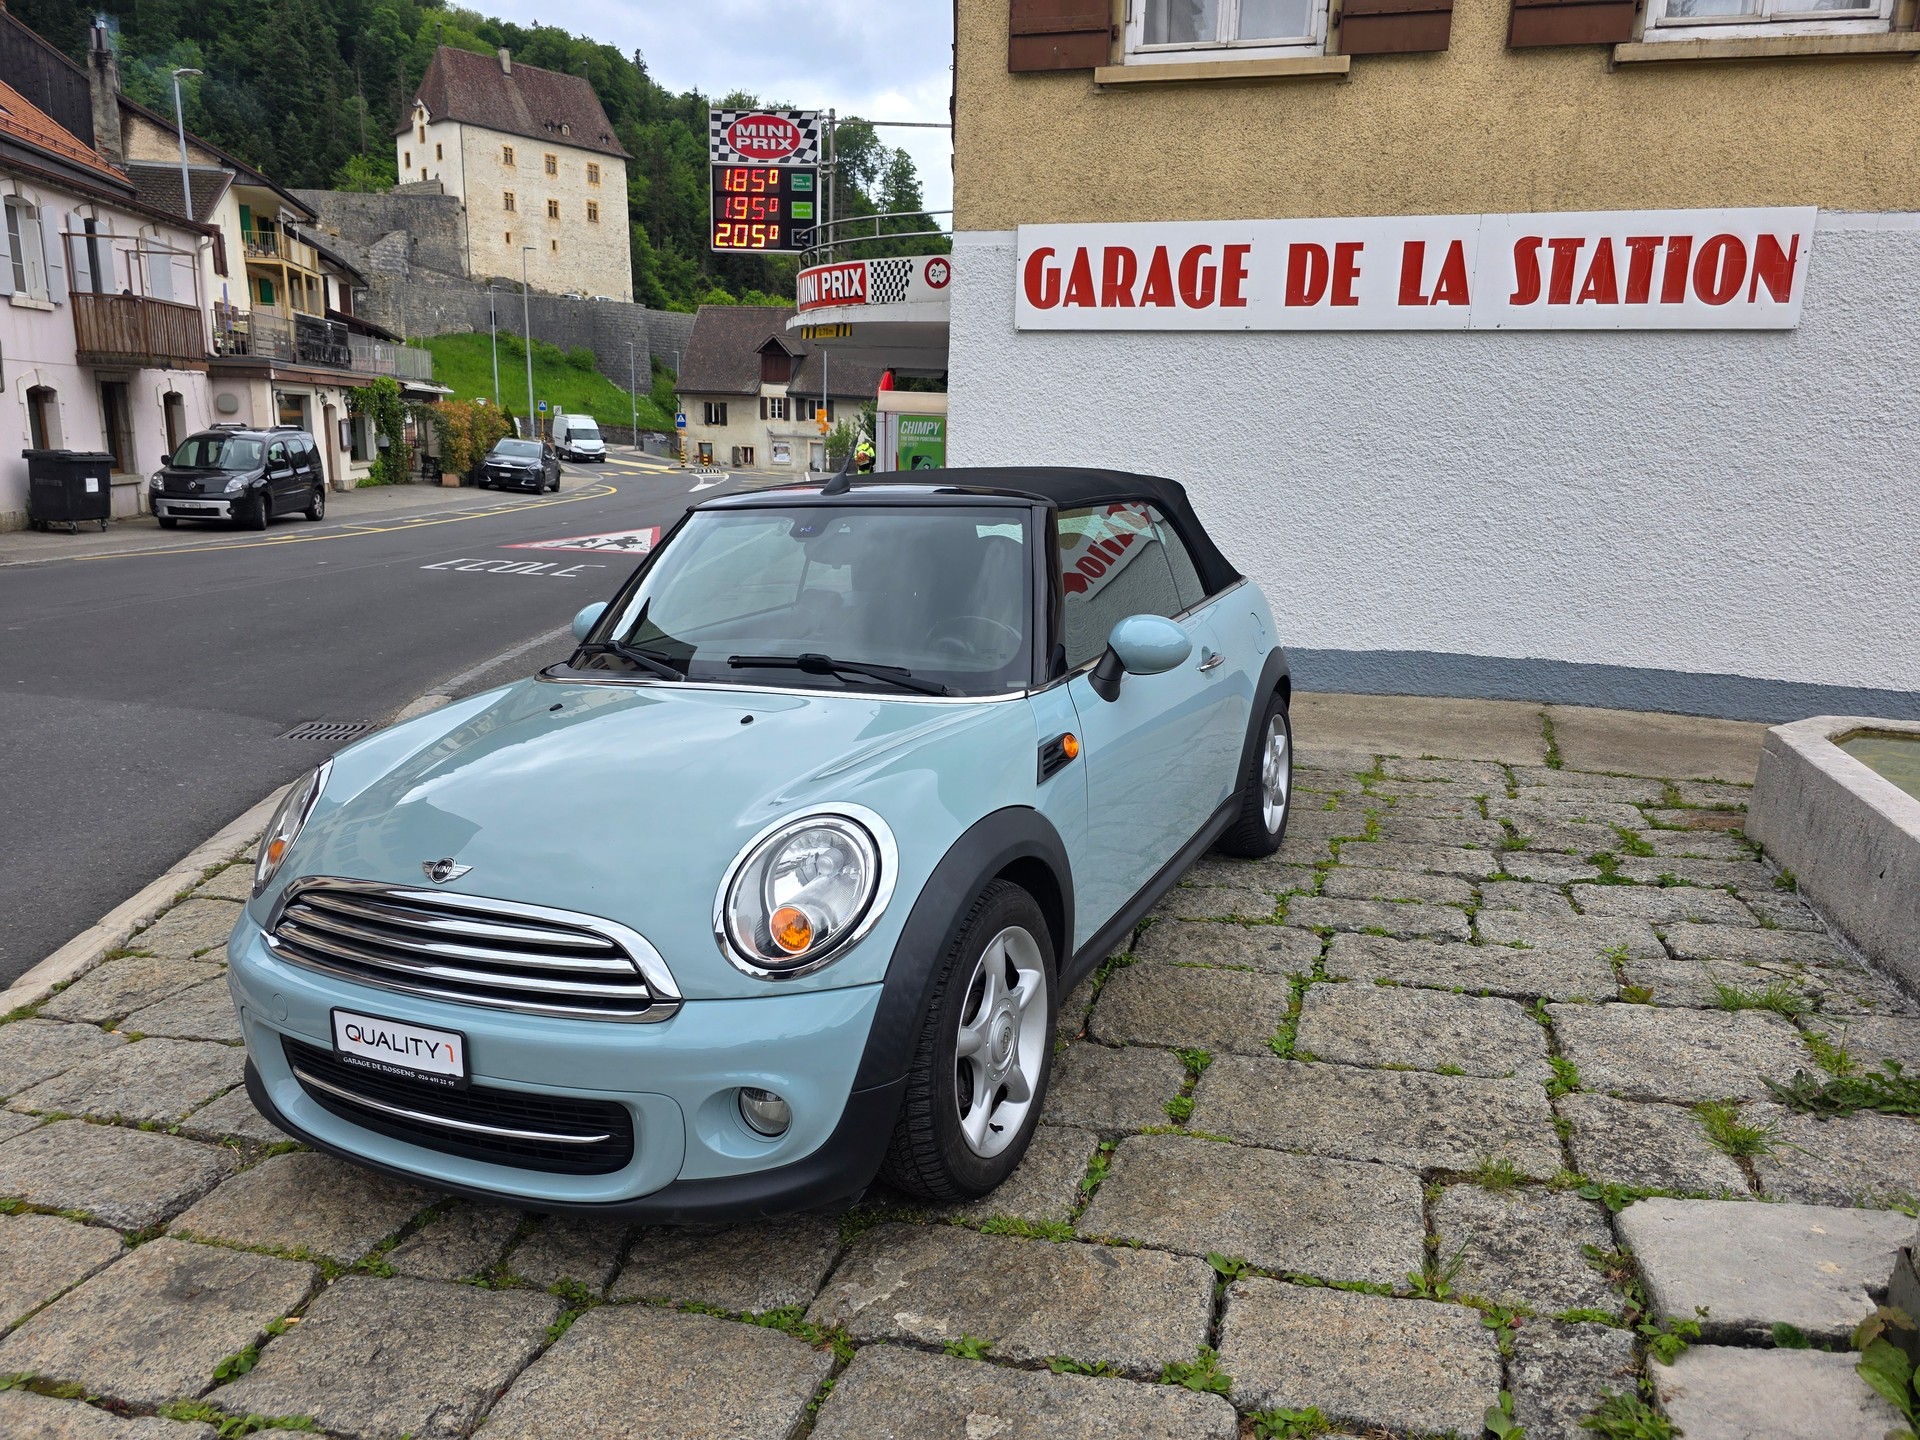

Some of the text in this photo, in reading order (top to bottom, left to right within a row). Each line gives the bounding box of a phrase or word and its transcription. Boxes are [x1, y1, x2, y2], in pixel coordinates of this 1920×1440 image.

[735, 123, 793, 138] MINI
[735, 137, 794, 151] PRIX
[1023, 233, 1800, 309] GARAGE DE LA STATION
[800, 268, 864, 303] MINI PRIX
[901, 421, 941, 435] CHIMPY
[419, 558, 607, 577] ECOLE
[345, 1024, 440, 1059] QUALITY
[343, 1056, 371, 1068] GARAGE
[371, 1062, 382, 1071] DE
[382, 1064, 416, 1078] ROSSENS
[418, 1073, 429, 1081] 026
